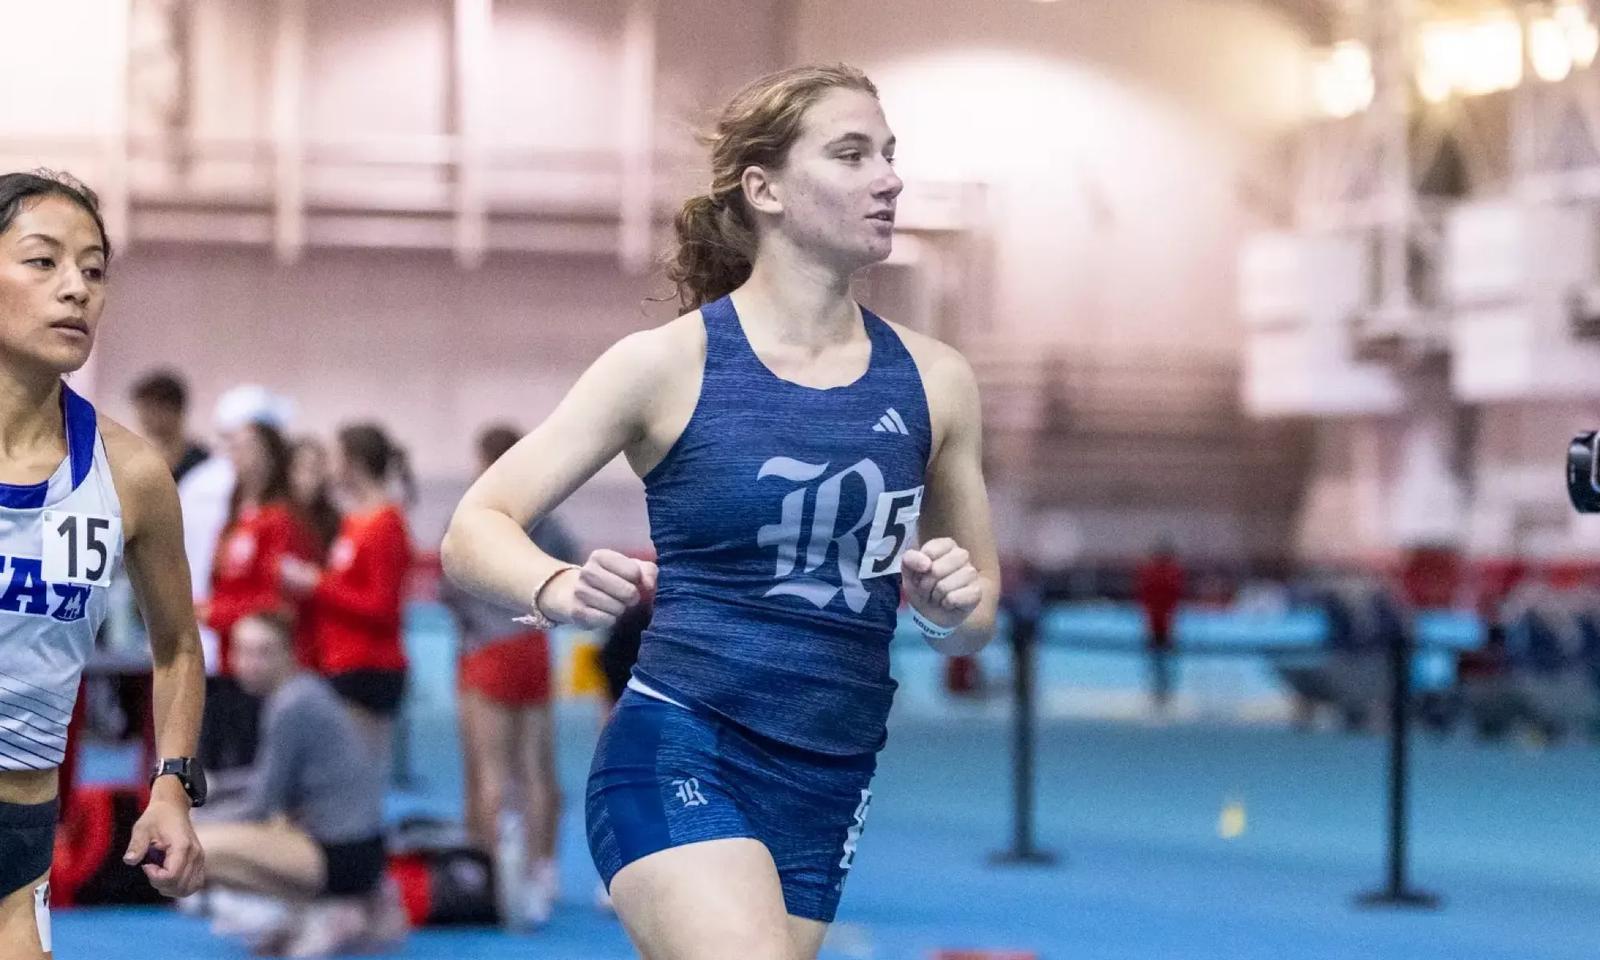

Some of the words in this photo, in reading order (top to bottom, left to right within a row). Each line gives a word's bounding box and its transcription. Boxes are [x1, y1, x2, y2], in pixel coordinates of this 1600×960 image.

[57, 516, 109, 581] 15
[757, 456, 885, 614] R
[872, 494, 915, 573] 5
[671, 777, 709, 808] R
